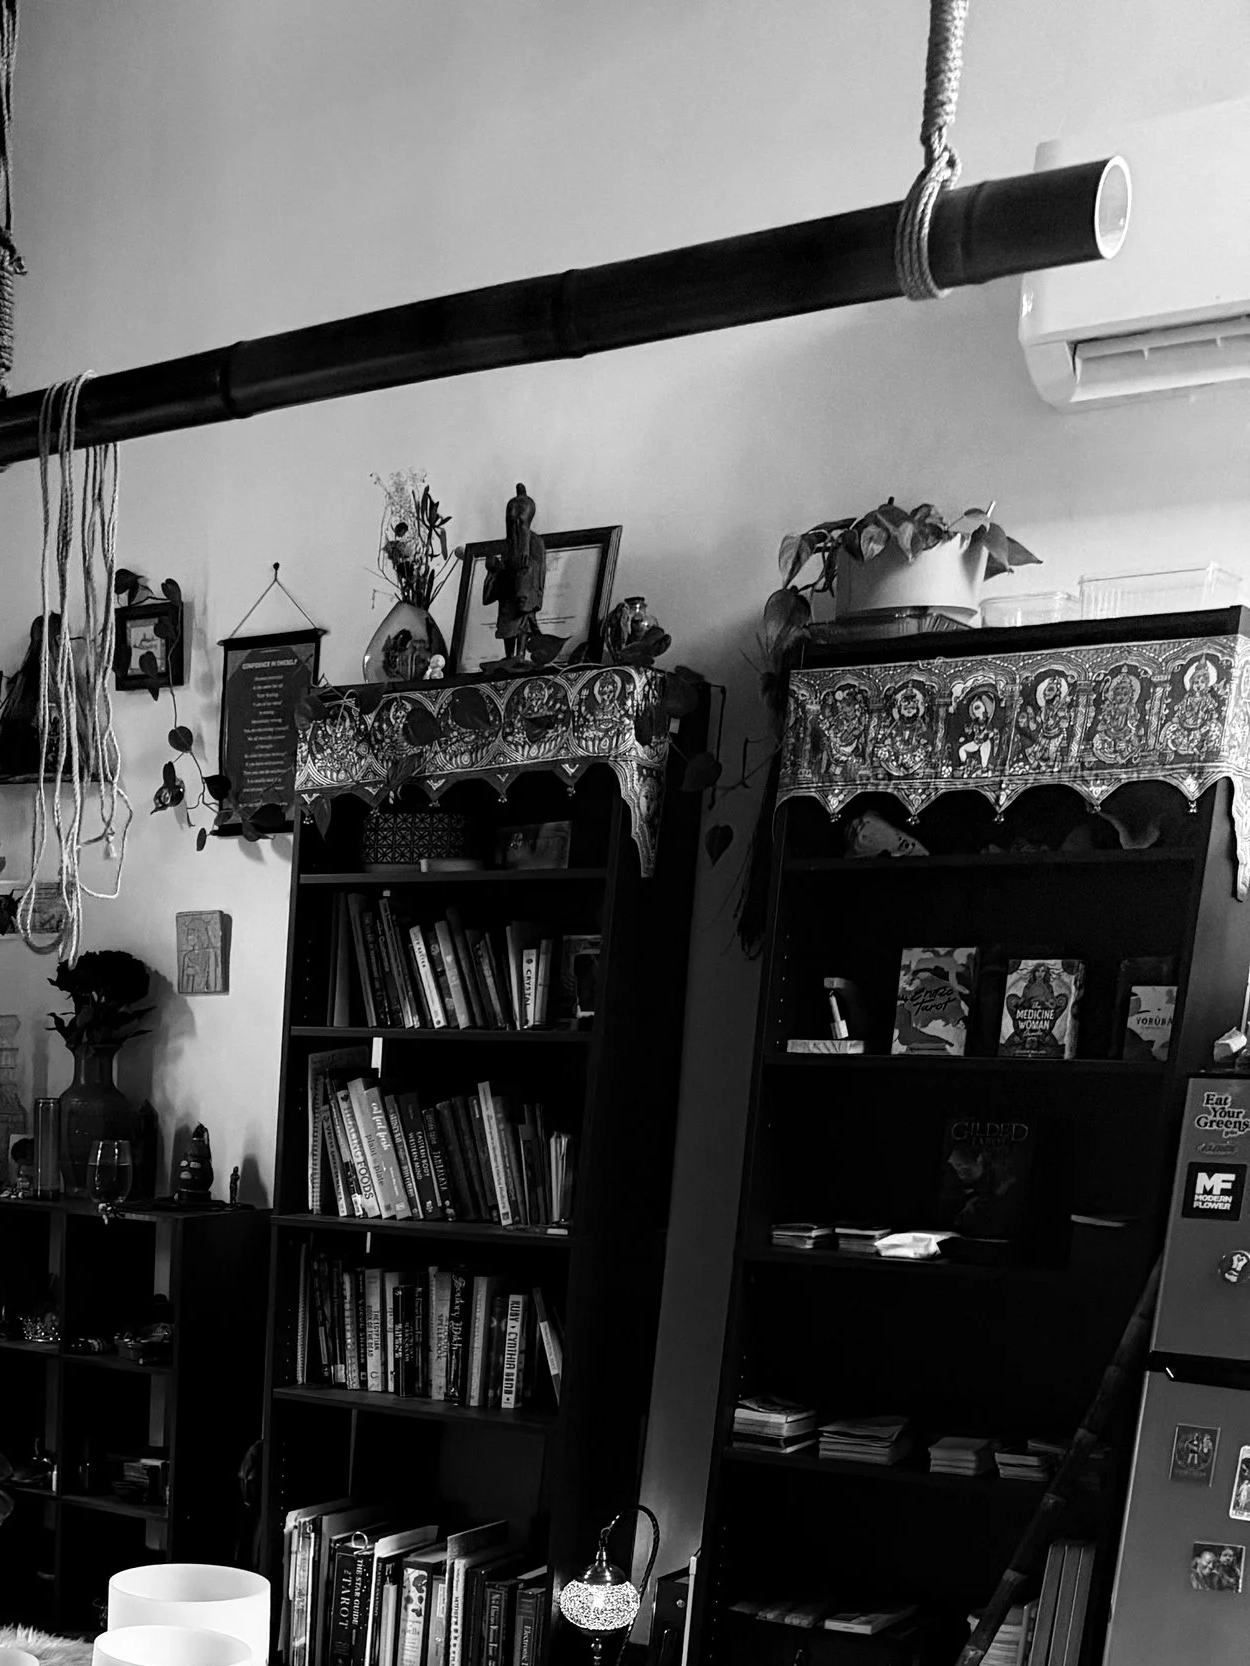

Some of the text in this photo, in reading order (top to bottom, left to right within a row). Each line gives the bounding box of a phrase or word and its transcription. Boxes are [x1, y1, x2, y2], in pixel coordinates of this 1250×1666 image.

[524, 968, 532, 1007] CRYSTAL
[913, 997, 956, 1016] Tarot
[1016, 1009, 1055, 1020] MEDICINE
[1018, 1020, 1050, 1030] WOMAN
[1205, 1094, 1229, 1105] Eat
[1211, 1107, 1243, 1118] Your
[1196, 1116, 1249, 1132] Greens
[408, 1131, 422, 1180] WESTERN MIND
[416, 1130, 430, 1178] EASTERN BODY
[357, 1160, 374, 1200] FOODS
[373, 1165, 385, 1187] plate
[1195, 1172, 1236, 1195] MF
[1193, 1201, 1231, 1211] FLOWER
[1194, 1194, 1232, 1203] MODERN
[505, 1331, 518, 1370] CYNTHIA
[338, 1575, 352, 1630] TAROT
[351, 1558, 364, 1626] THE STAR GUIDE
[521, 1624, 531, 1661] Electronic
